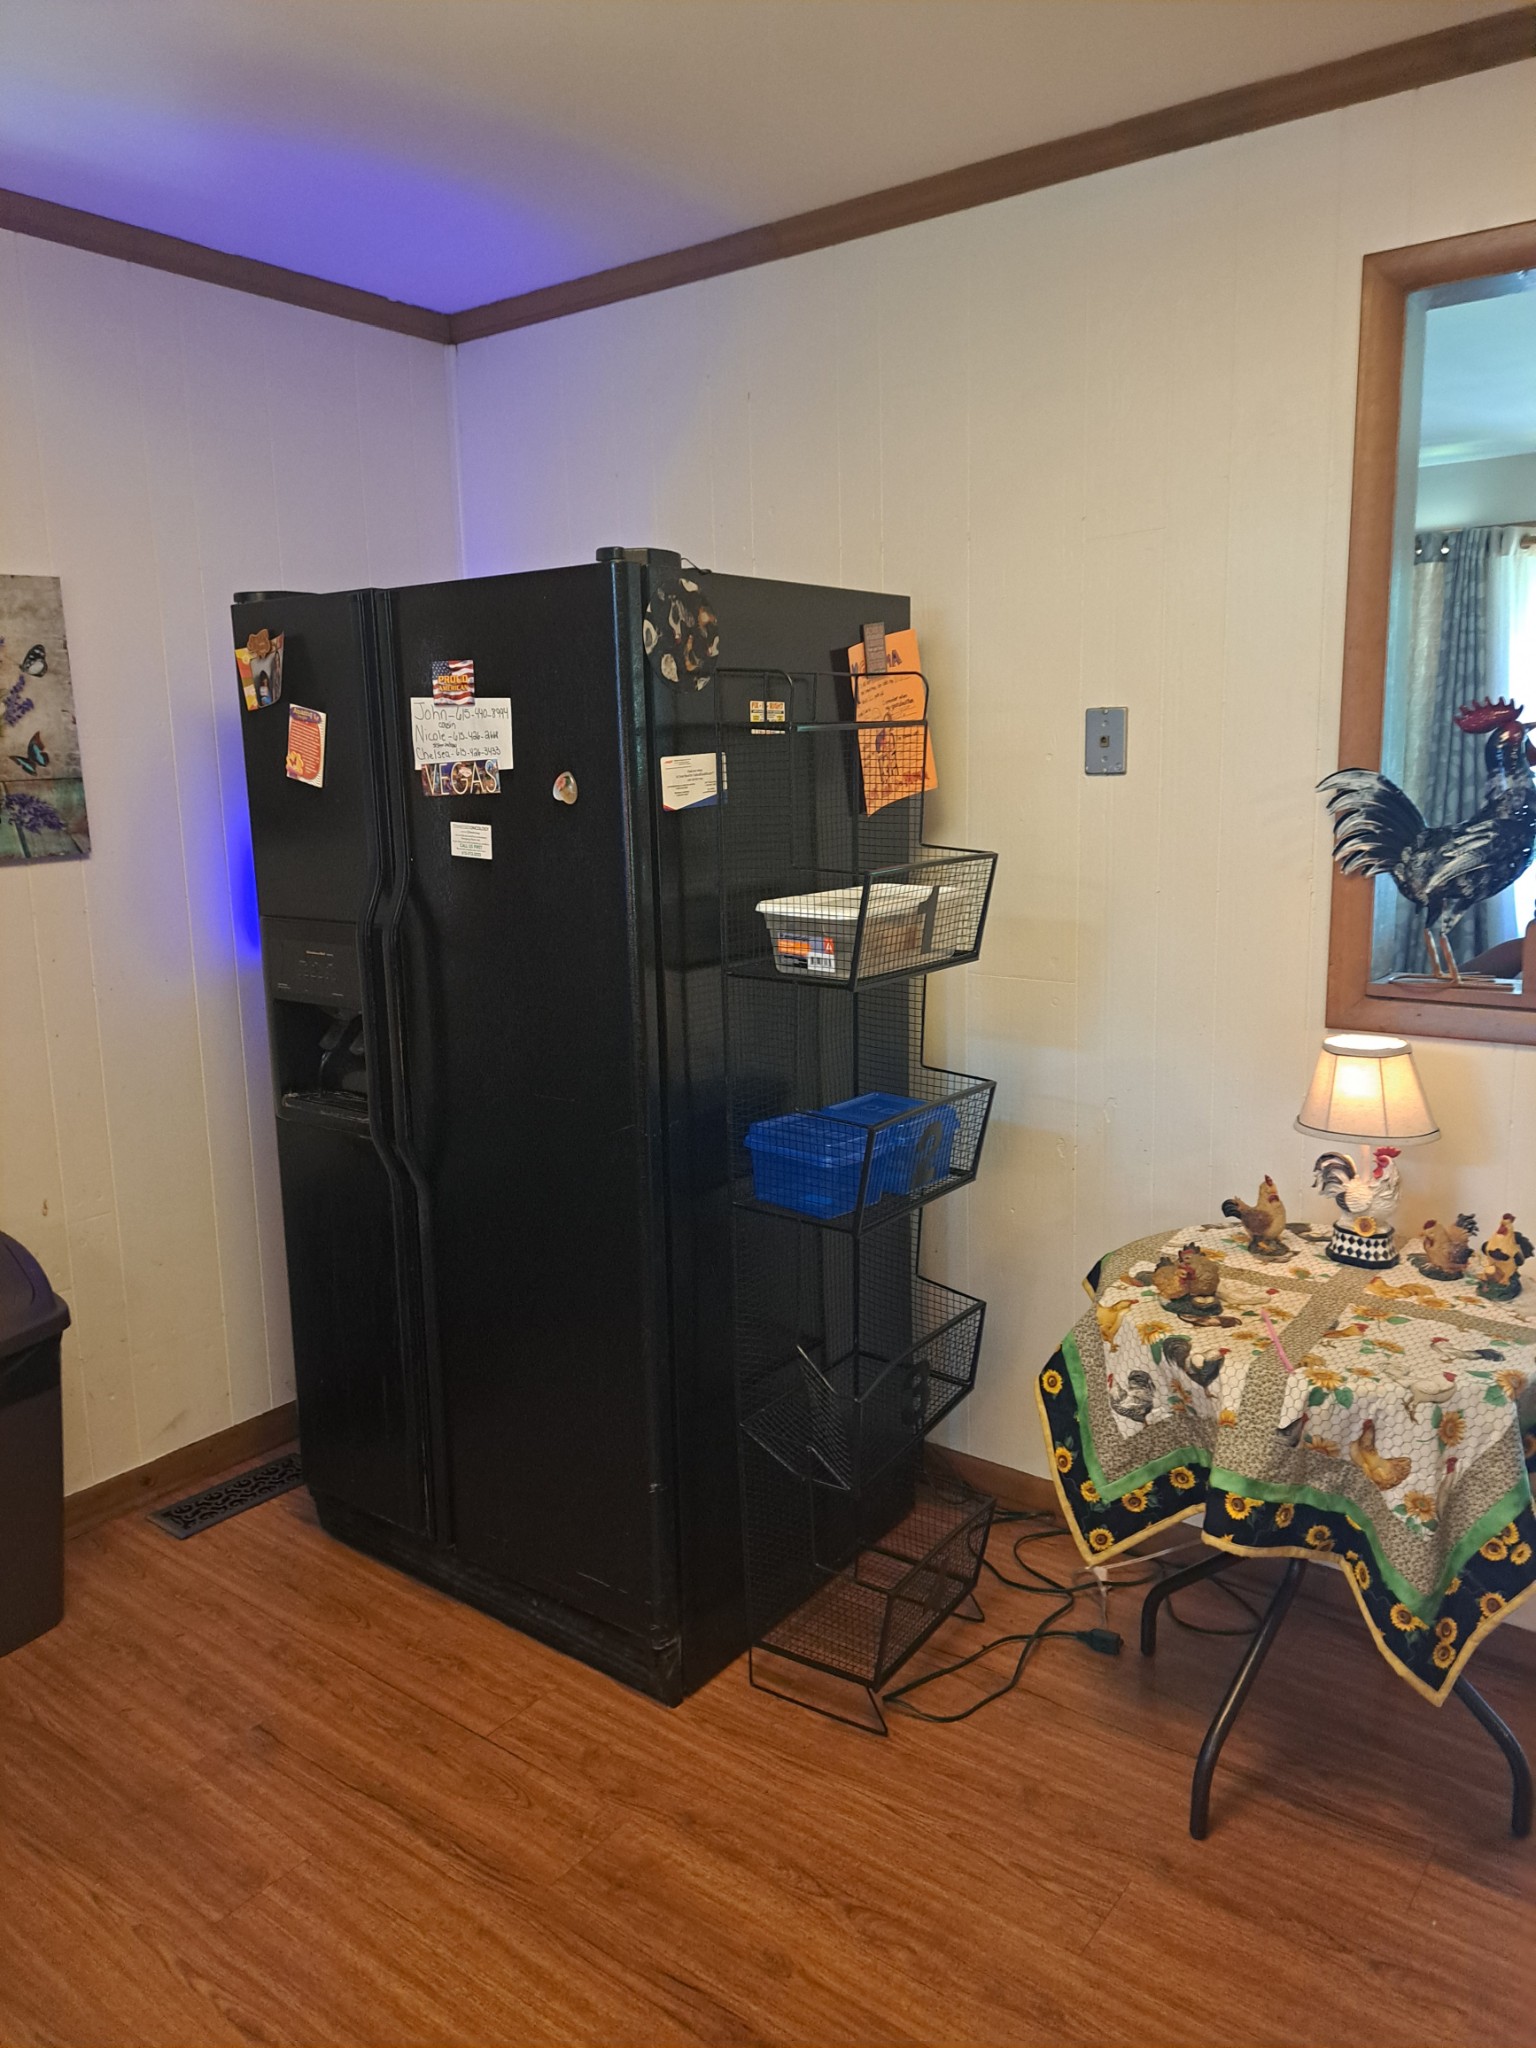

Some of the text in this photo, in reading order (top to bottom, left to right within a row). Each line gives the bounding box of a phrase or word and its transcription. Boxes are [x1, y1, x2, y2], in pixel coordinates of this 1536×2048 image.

[438, 675, 468, 684] PROUD
[415, 725, 446, 743] Nicole
[421, 760, 498, 796] VEGAS
[918, 885, 940, 954] 1
[909, 1120, 943, 1190] 2
